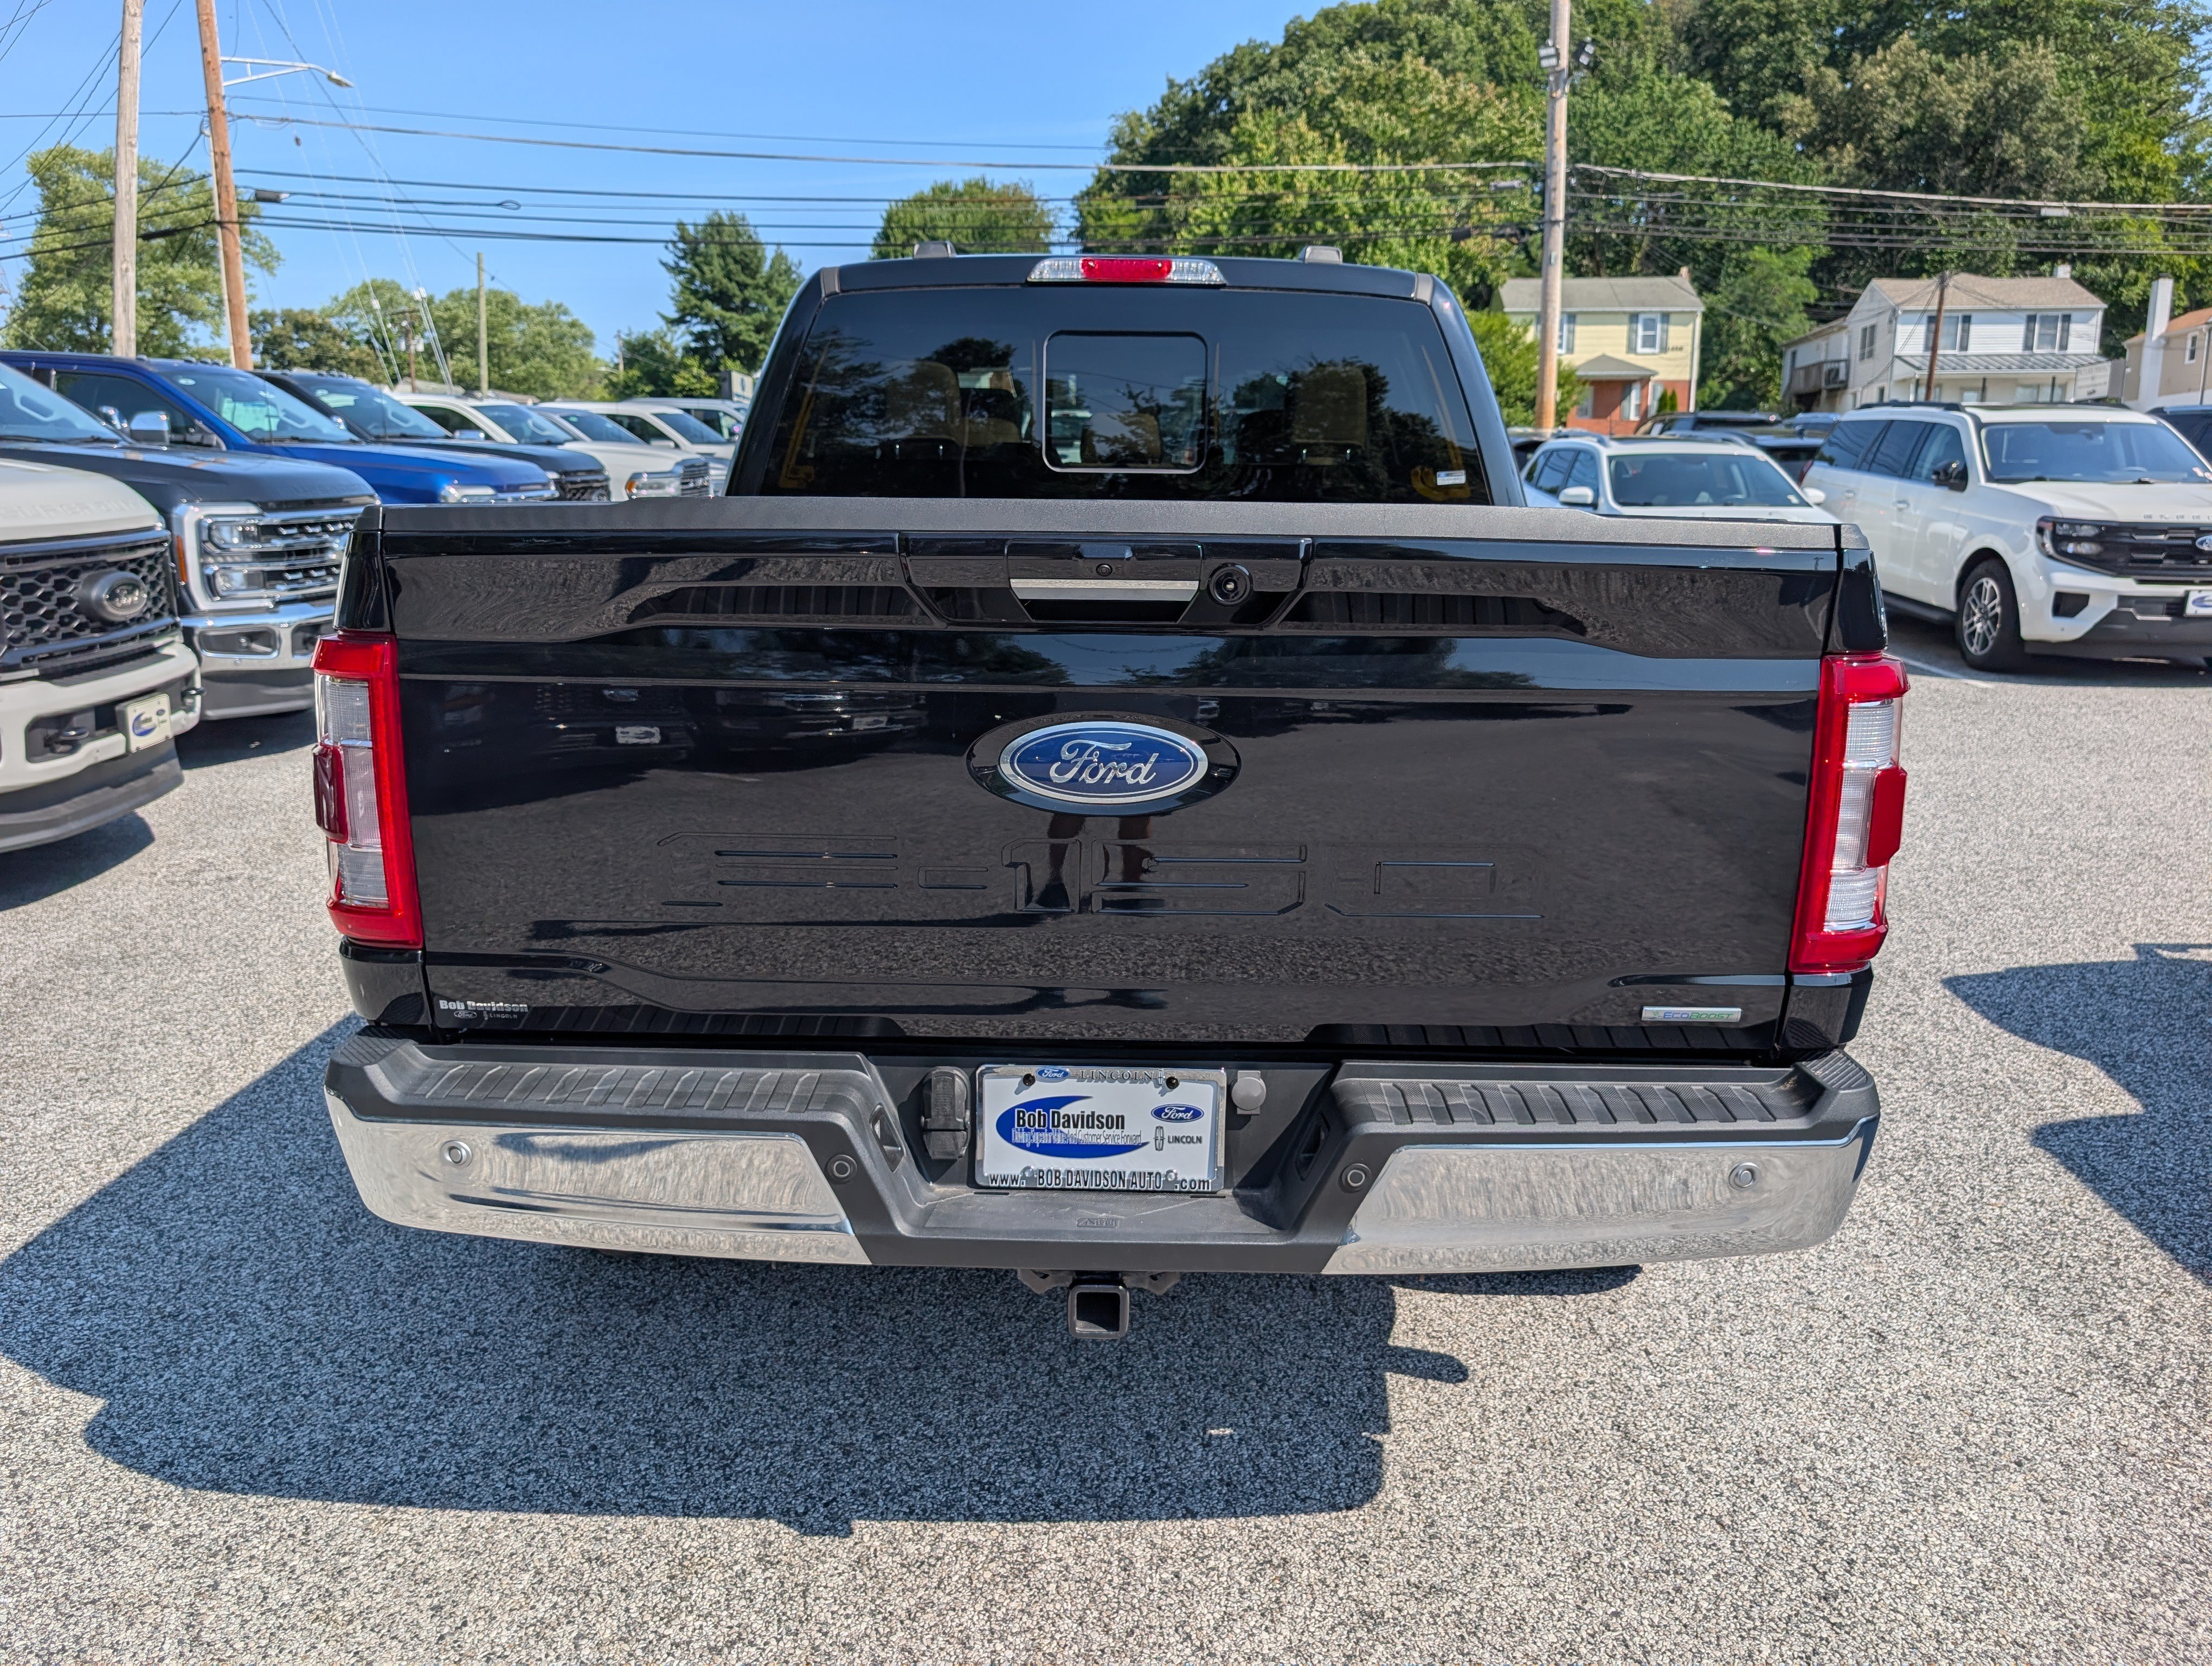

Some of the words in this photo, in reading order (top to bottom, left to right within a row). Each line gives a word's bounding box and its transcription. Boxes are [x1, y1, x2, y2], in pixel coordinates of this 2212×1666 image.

[1050, 740, 1159, 785] Ford
[439, 1000, 465, 1009] Bob
[467, 1001, 528, 1012] Davidson
[1042, 1068, 1064, 1078] Ford
[1079, 1070, 1154, 1080] LINCOLN
[1016, 1109, 1047, 1129] Bob
[1051, 1110, 1126, 1130] Davidson
[1161, 1106, 1194, 1120] Ford
[1031, 1129, 1053, 1147] Superior
[1078, 1130, 1102, 1144] Customer
[1102, 1130, 1121, 1144] Service
[1121, 1130, 1142, 1144] Forward
[1168, 1135, 1202, 1144] LINCOLN
[1037, 1168, 1063, 1187] BOB
[1065, 1169, 1127, 1189] DAVIDSON
[1129, 1170, 1163, 1190] AUTO
